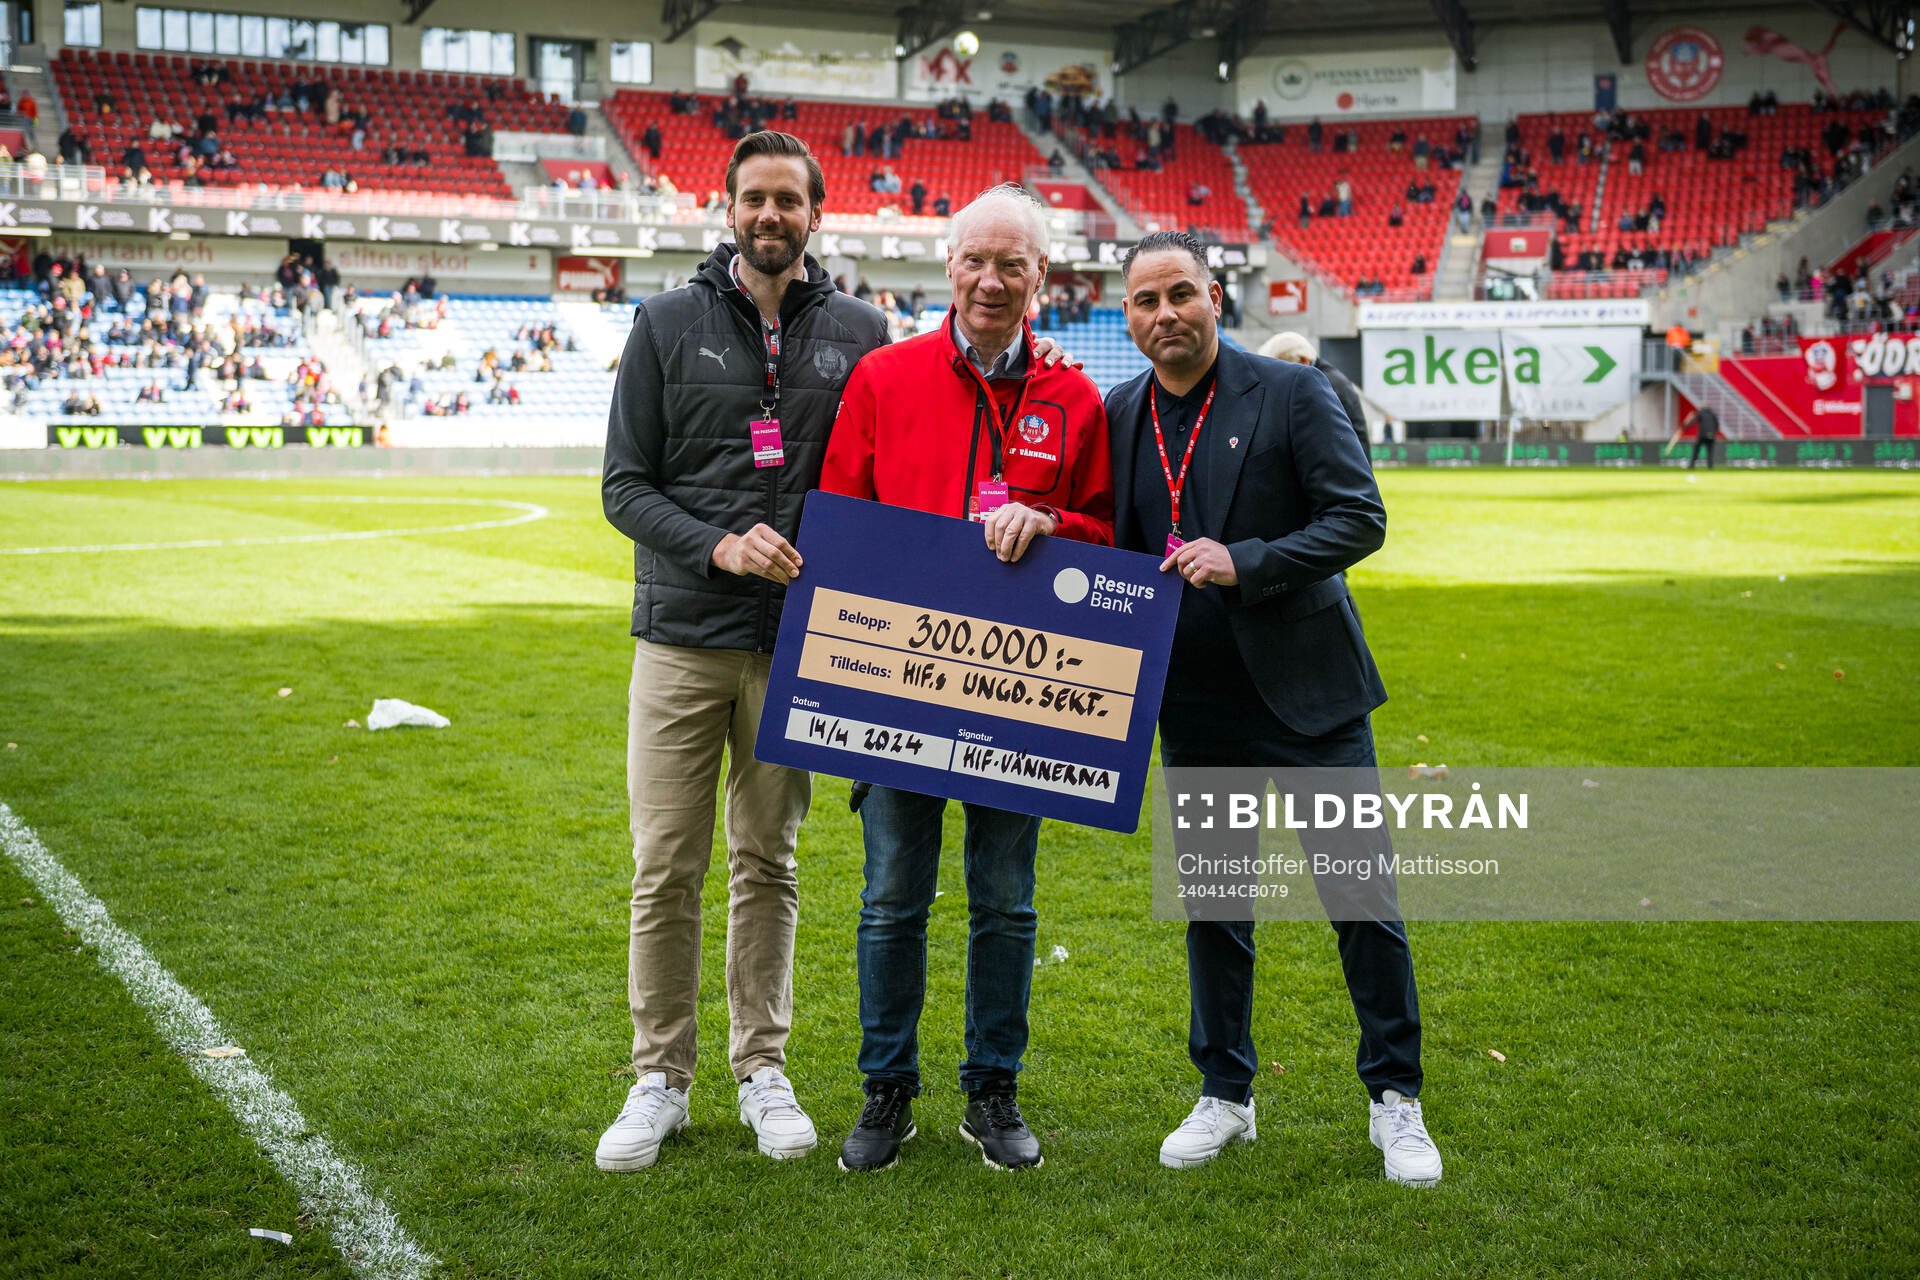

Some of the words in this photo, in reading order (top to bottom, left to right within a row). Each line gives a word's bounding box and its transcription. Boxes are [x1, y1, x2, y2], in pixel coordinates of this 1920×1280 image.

[164, 241, 213, 263] och
[1093, 574, 1155, 600] Resurs
[1091, 592, 1134, 614] Bank
[838, 609, 892, 632] Belopp:
[829, 655, 893, 679] Tilldelas:
[792, 695, 820, 709] Datum
[808, 715, 849, 748] 14/4
[863, 727, 924, 756] 2024
[957, 728, 994, 743] Signatur
